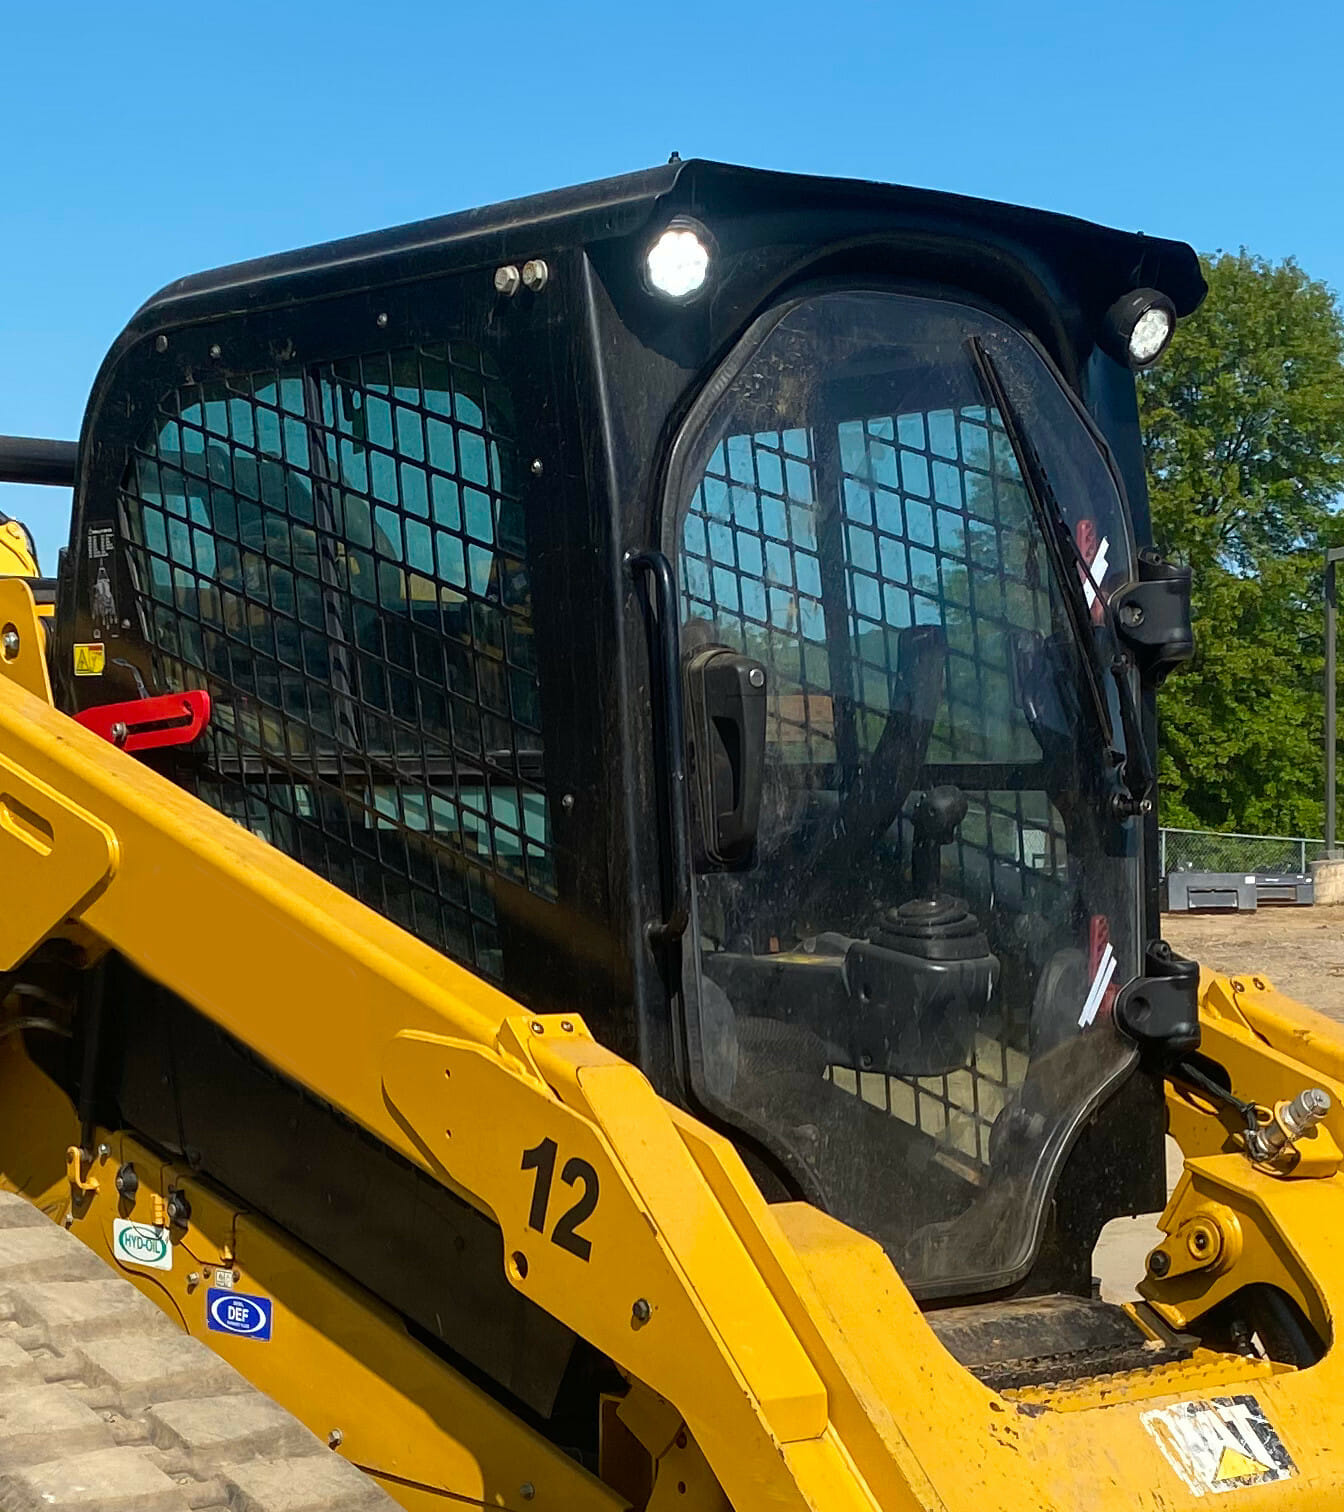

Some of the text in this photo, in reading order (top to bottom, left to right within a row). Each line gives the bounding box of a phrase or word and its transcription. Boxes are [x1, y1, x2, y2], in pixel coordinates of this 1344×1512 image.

[521, 1136, 600, 1263] 12
[125, 1232, 160, 1254] HYD-OIL
[228, 1305, 249, 1322] DEF
[1140, 1402, 1282, 1497] CAT
